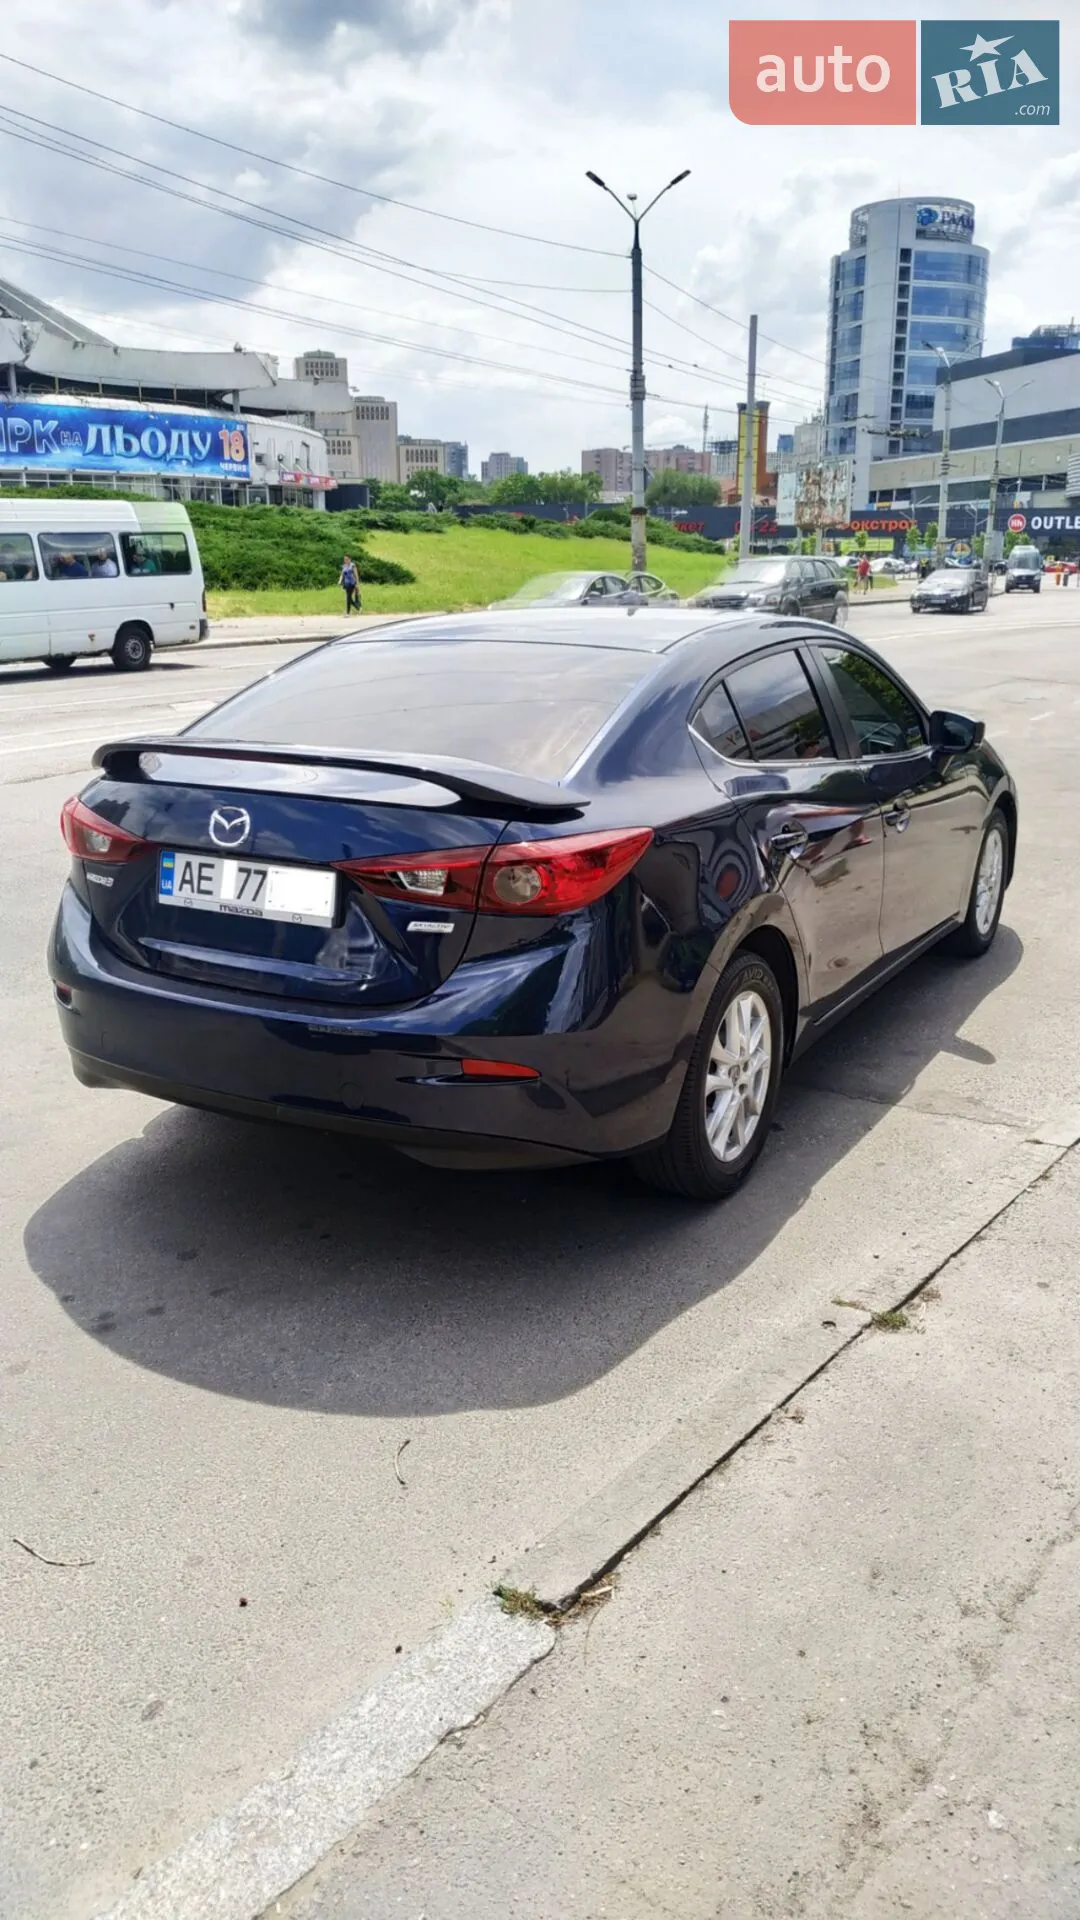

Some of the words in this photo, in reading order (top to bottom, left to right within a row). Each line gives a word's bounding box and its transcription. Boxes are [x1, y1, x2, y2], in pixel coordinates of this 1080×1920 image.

[0, 417, 60, 454] РК
[60, 431, 83, 446] НА
[83, 423, 212, 464] ЛЬОДУ
[219, 429, 246, 462] 18
[161, 880, 173, 890] UA
[179, 860, 215, 896] AE
[237, 867, 268, 902] 77
[219, 904, 264, 917] mazda
